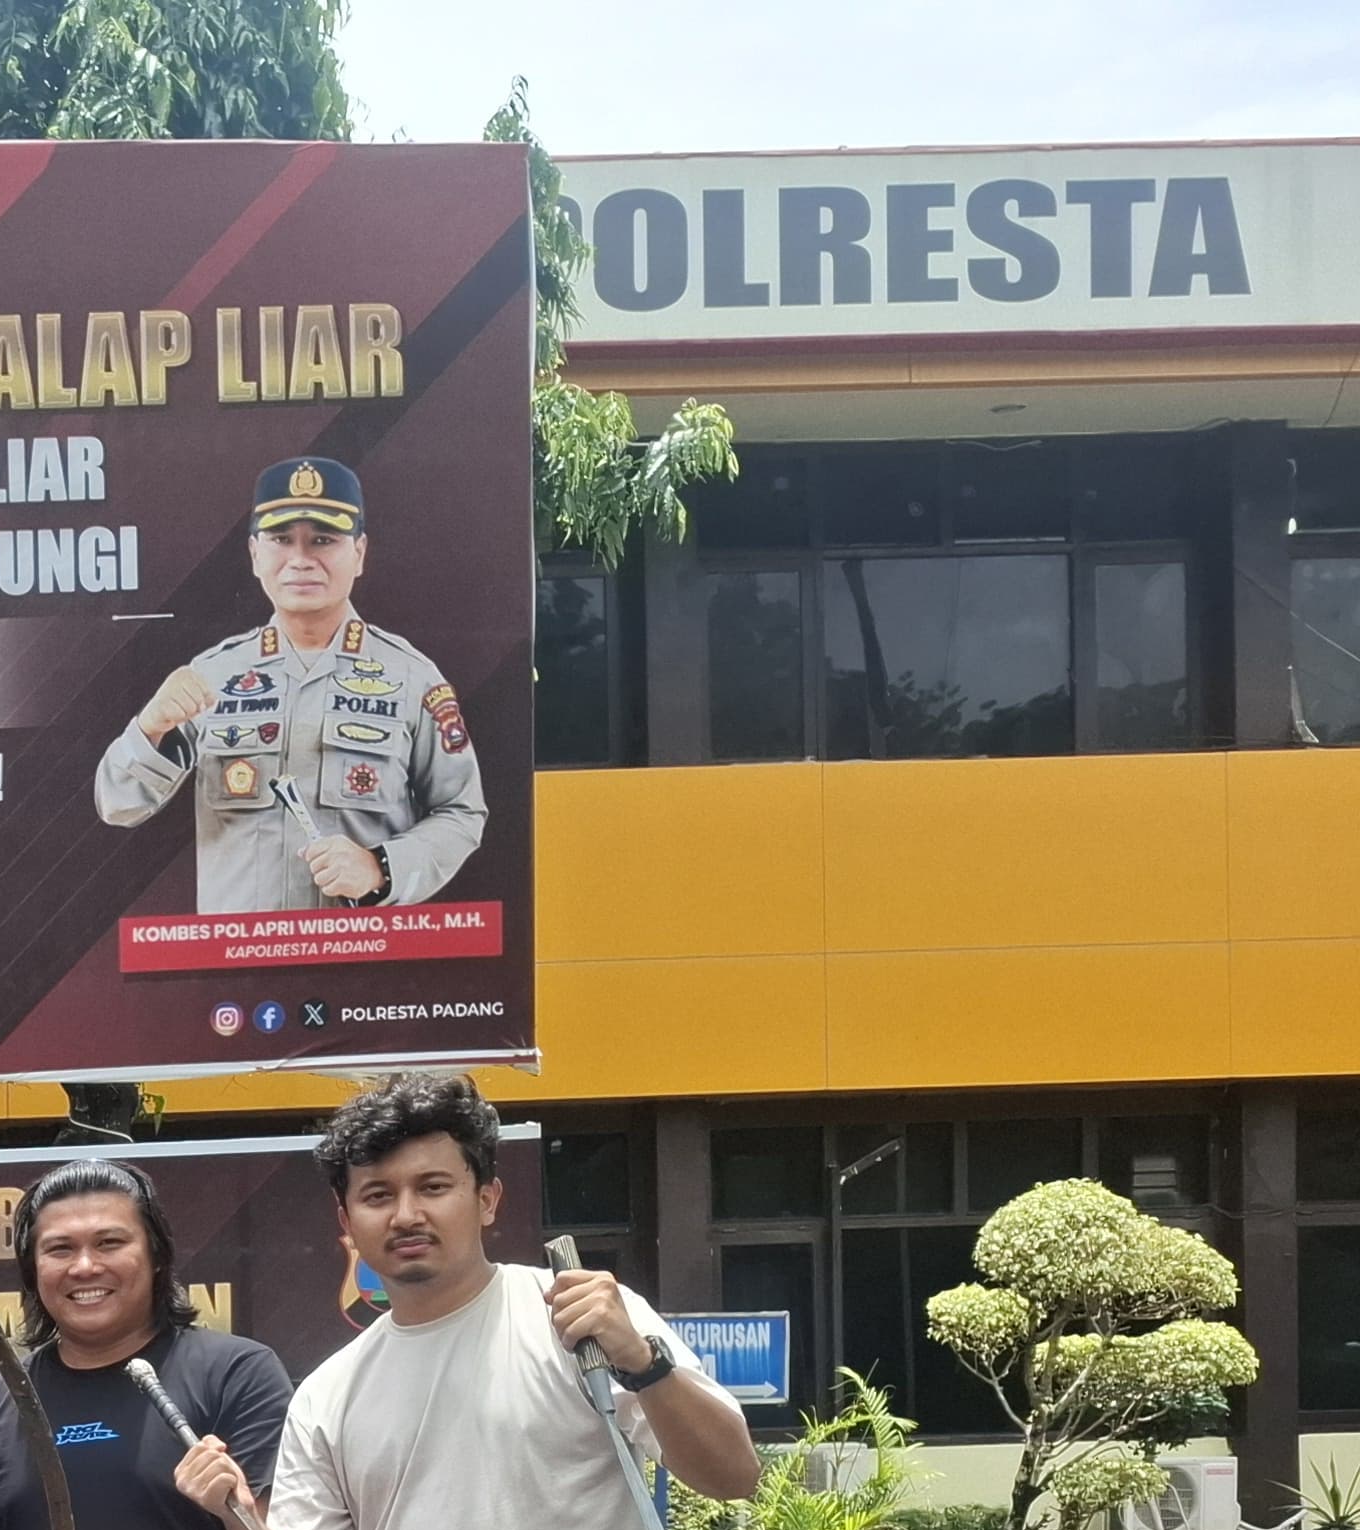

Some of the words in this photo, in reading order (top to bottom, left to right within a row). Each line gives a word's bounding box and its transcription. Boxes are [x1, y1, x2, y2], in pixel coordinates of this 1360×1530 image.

[559, 175, 1252, 312] OLRESTA
[216, 302, 404, 403] LIAR
[333, 695, 397, 718] POLRI
[132, 924, 211, 944] KOMBES
[214, 922, 248, 940] POL
[252, 920, 294, 938] APRI
[298, 916, 388, 937] WIBOWO,
[392, 913, 440, 933] S.I.K.,
[444, 911, 485, 930] M.H.
[225, 942, 319, 961] KAPOLRESTA
[323, 938, 387, 956] PADANG
[341, 1005, 428, 1023] POLRESTA
[432, 1002, 505, 1019] PADANG
